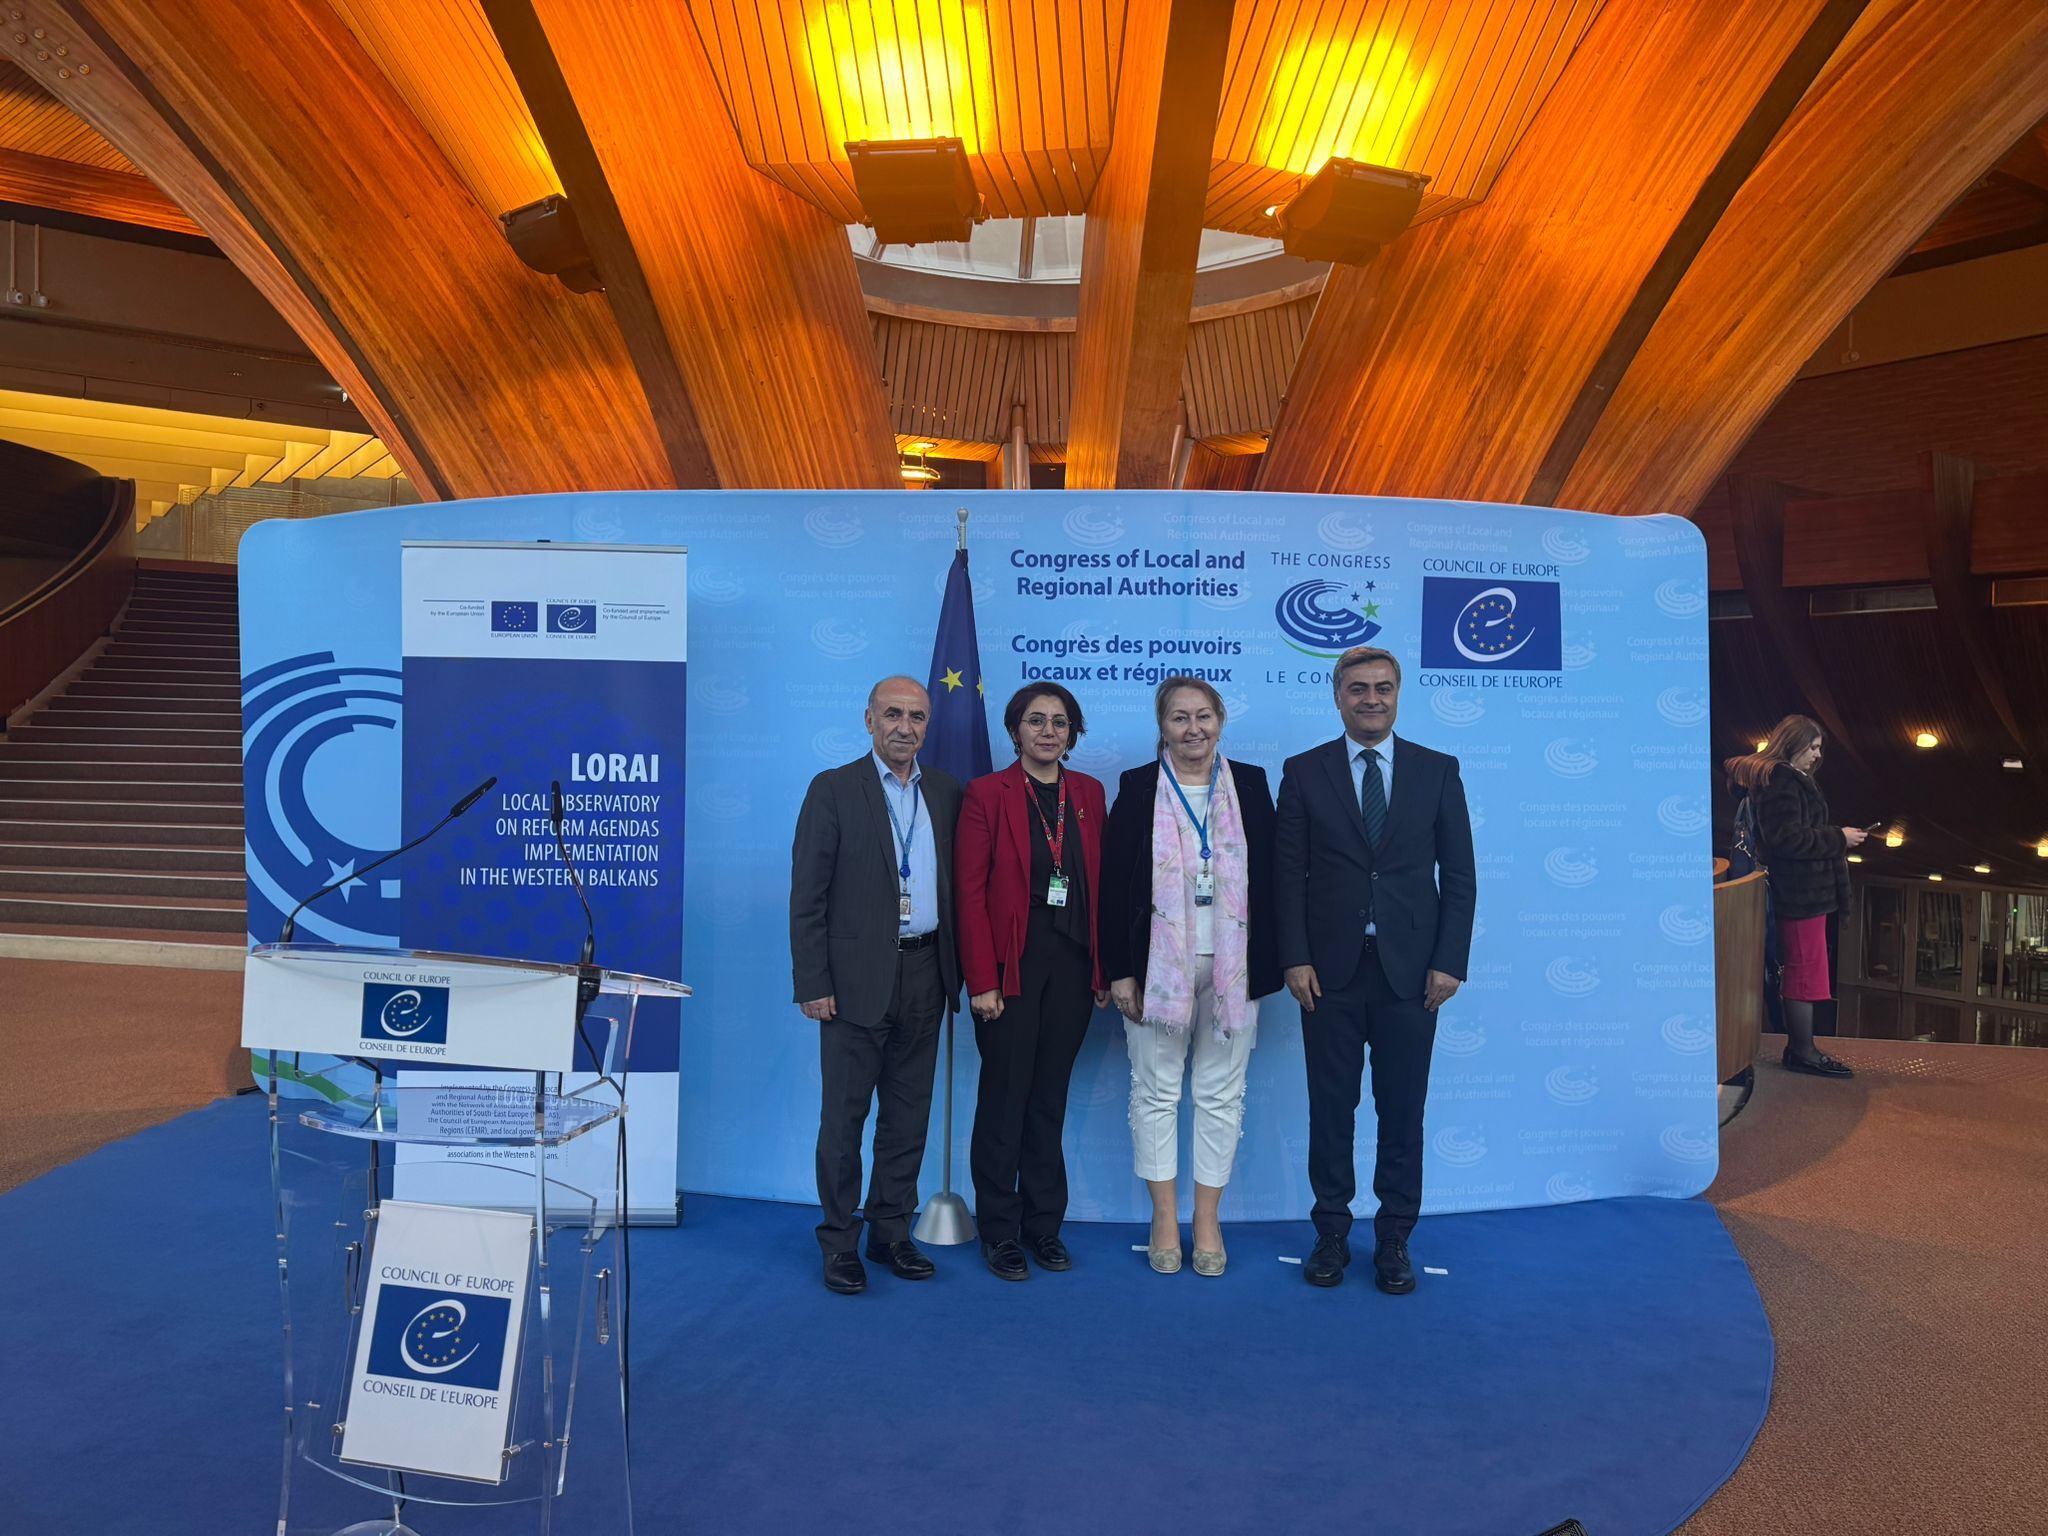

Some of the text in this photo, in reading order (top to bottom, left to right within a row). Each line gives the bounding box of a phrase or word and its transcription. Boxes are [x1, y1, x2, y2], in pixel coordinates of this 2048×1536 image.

[1010, 548, 1245, 572] Congress of Local and
[1271, 552, 1391, 569] THE CONGRESS
[1423, 558, 1560, 577] COUNCIL OF EUROPE
[1017, 576, 1112, 600] Regional
[1118, 577, 1239, 597] Authorities
[1012, 634, 1101, 658] Congrès
[1106, 634, 1144, 654] des
[1149, 636, 1242, 659] pouvoirs
[1021, 661, 1232, 686] locaux et régionaux
[1266, 671, 1286, 684] LE
[1419, 674, 1478, 687] CONSEIL
[1482, 675, 1499, 688] DE
[571, 752, 659, 783] LORAI
[502, 793, 550, 811] LOCAL
[496, 818, 660, 837] ON REFORM AGENDAS
[525, 843, 659, 862] IMPLEMENTATION
[461, 868, 658, 887] IN THE WESTERN BALKANS
[363, 971, 451, 985] COUNCIL OF EUROPE
[359, 1041, 447, 1056] CONSEIL DE L'EUROPE
[508, 1111, 529, 1119] Europe
[440, 1127, 464, 1136] Regions
[492, 1151, 503, 1159] the
[504, 1151, 529, 1159] Western
[381, 1266, 515, 1293] COUNCIL OF EUROPE
[363, 1379, 499, 1410] CONSEIL DE L'EUROPE
